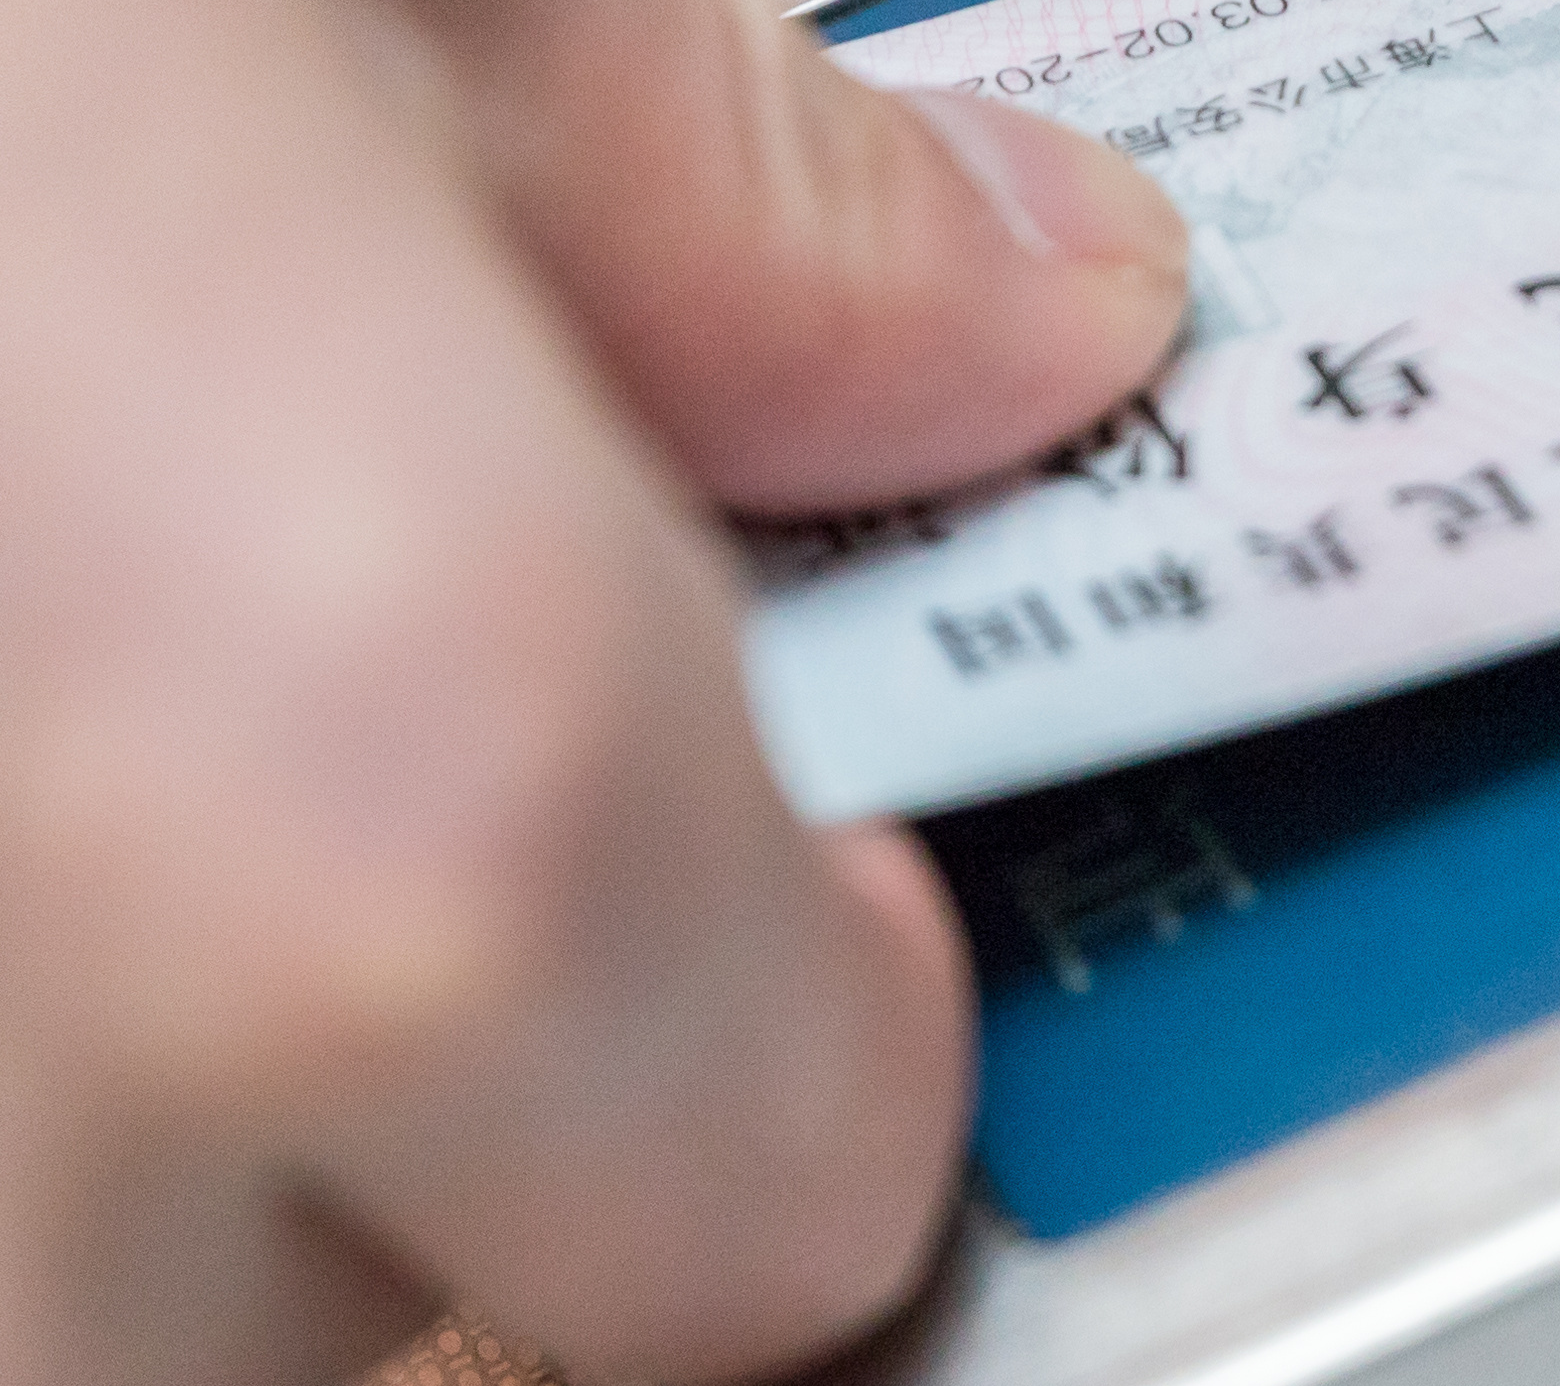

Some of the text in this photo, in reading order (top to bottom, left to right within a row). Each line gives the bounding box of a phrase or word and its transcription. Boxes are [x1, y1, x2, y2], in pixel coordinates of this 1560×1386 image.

[1105, 7, 1502, 157] 上海市公安局
